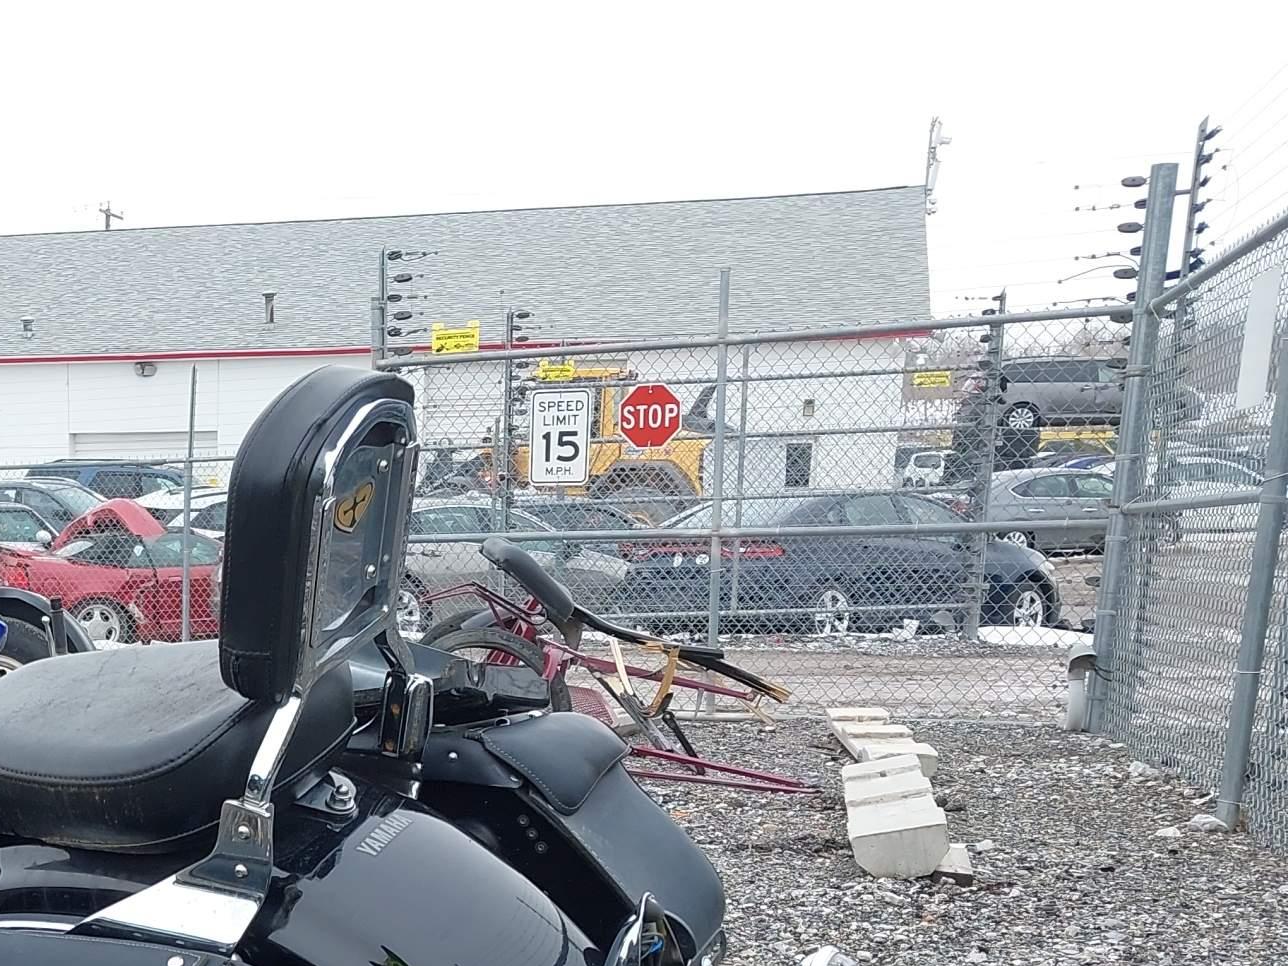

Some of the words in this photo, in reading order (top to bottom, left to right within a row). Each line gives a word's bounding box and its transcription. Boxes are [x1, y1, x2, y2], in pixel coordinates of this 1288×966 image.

[538, 400, 585, 413] SPEED
[622, 403, 679, 429] STOP
[543, 414, 580, 427] LIMIT
[542, 430, 580, 463] 15
[545, 466, 574, 476] M.P.H.
[356, 812, 413, 855] YAMAHA
